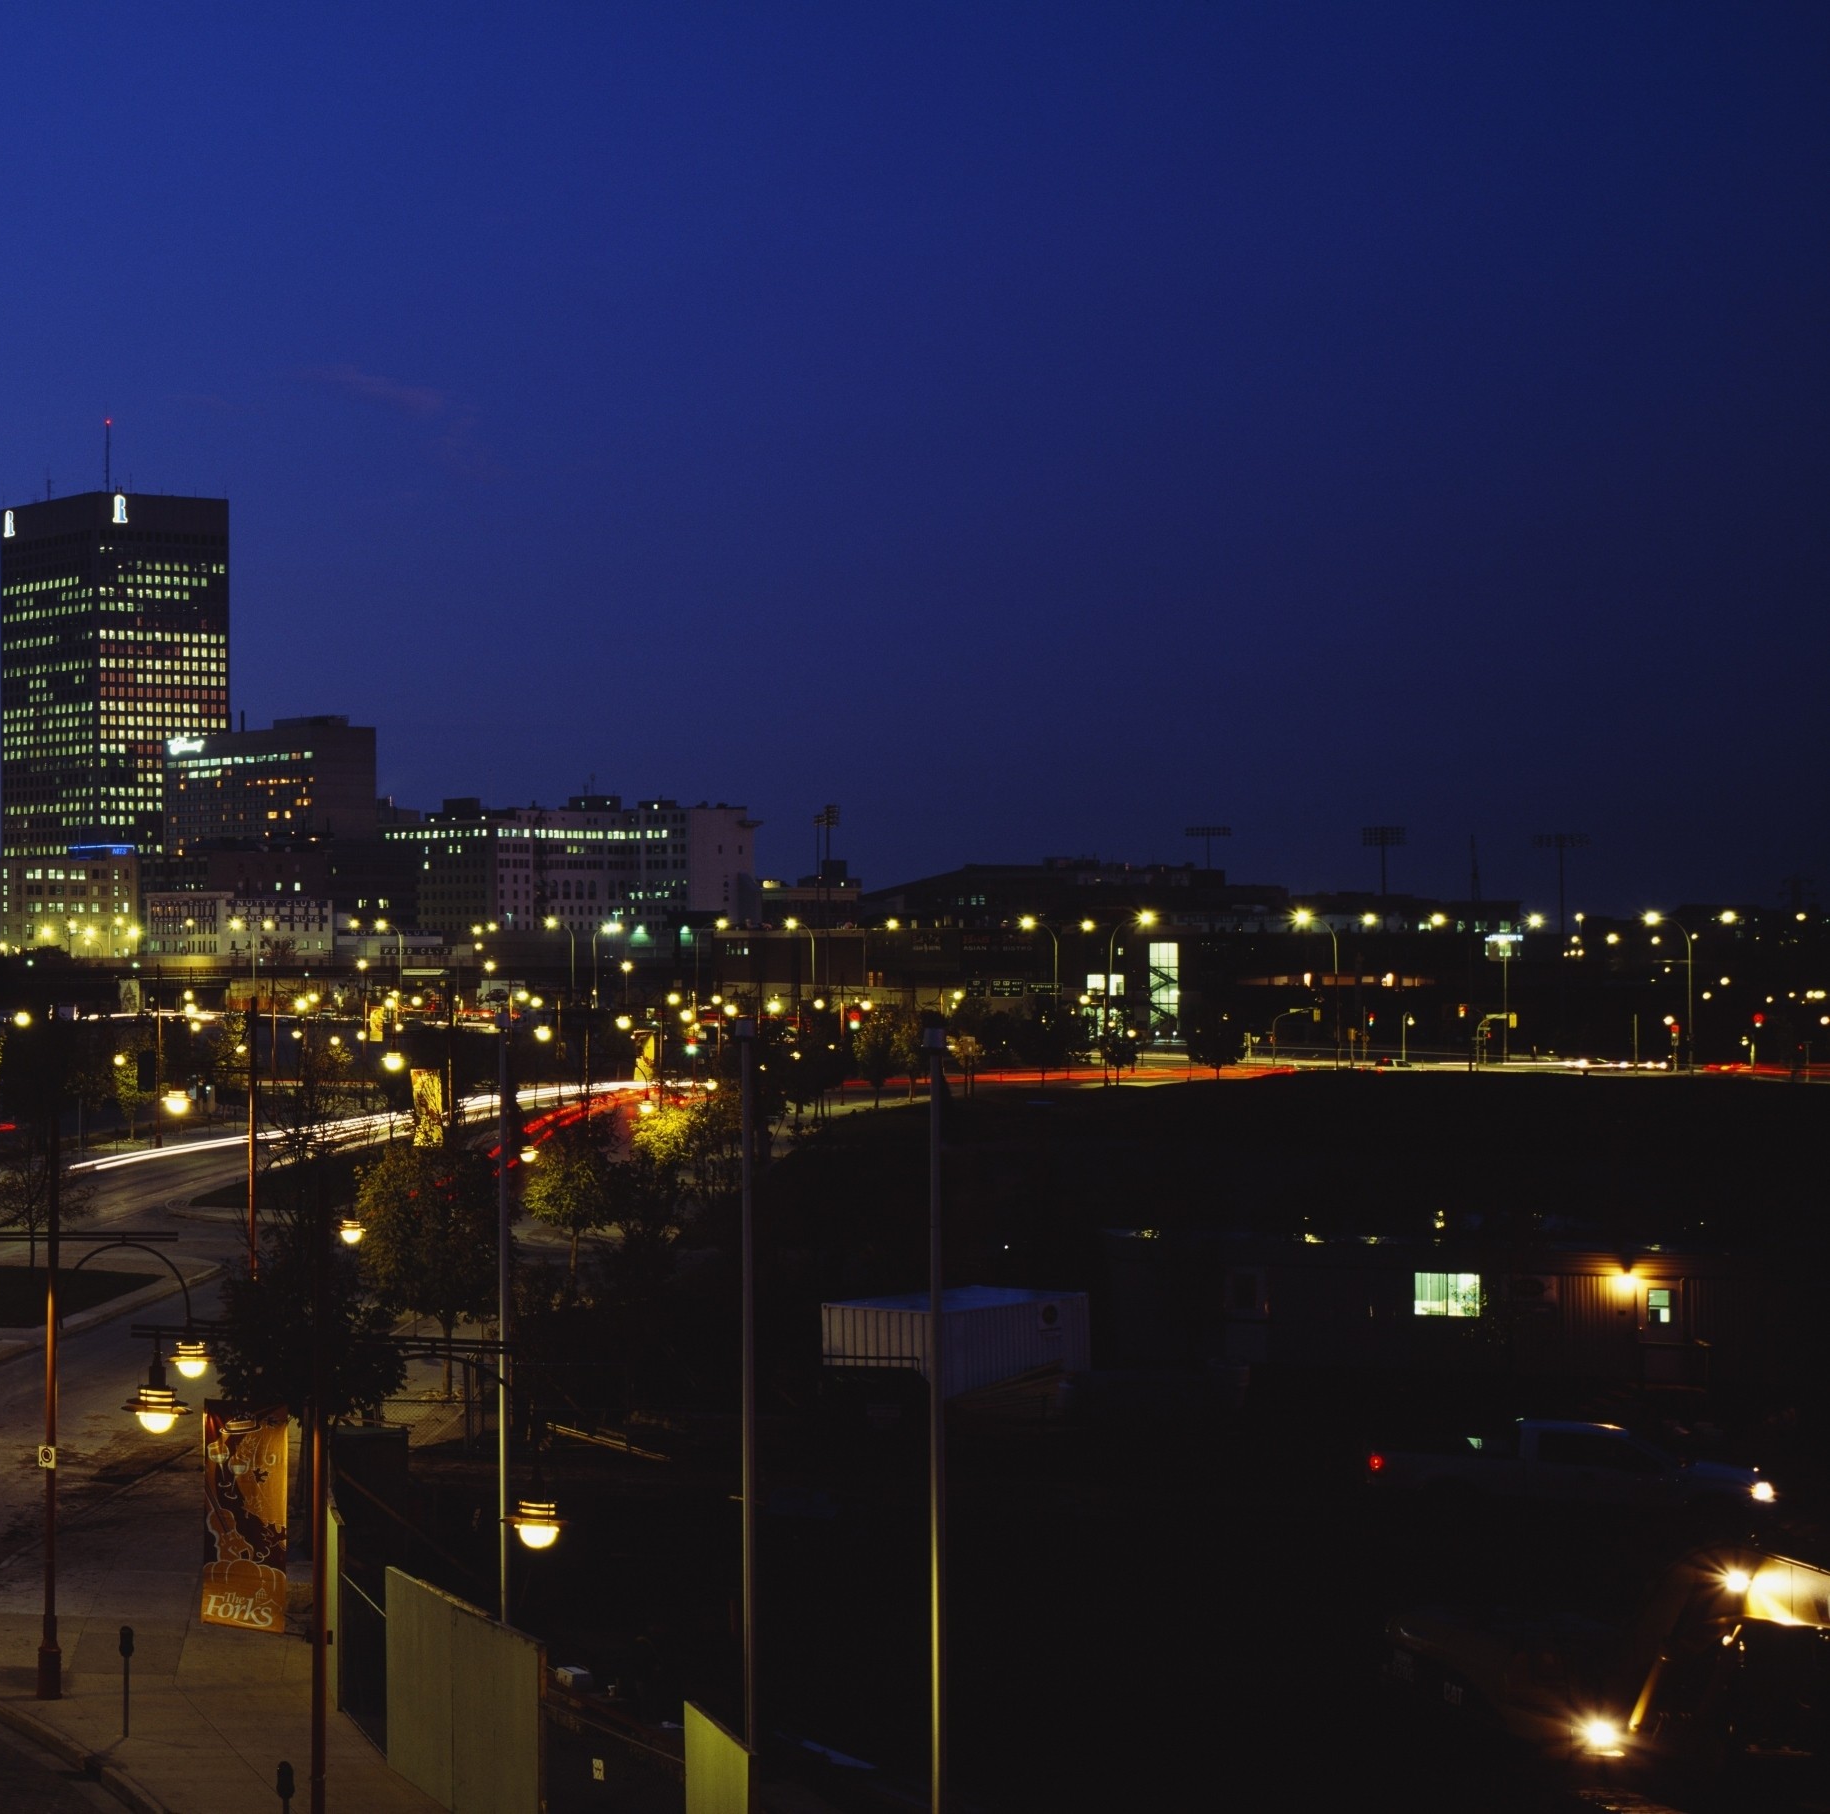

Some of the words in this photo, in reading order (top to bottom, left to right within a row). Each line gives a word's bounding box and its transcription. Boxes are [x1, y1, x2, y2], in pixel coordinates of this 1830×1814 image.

[203, 1594, 274, 1626] Forks
[224, 1592, 245, 1605] The
[1443, 1681, 1464, 1706] CAT
